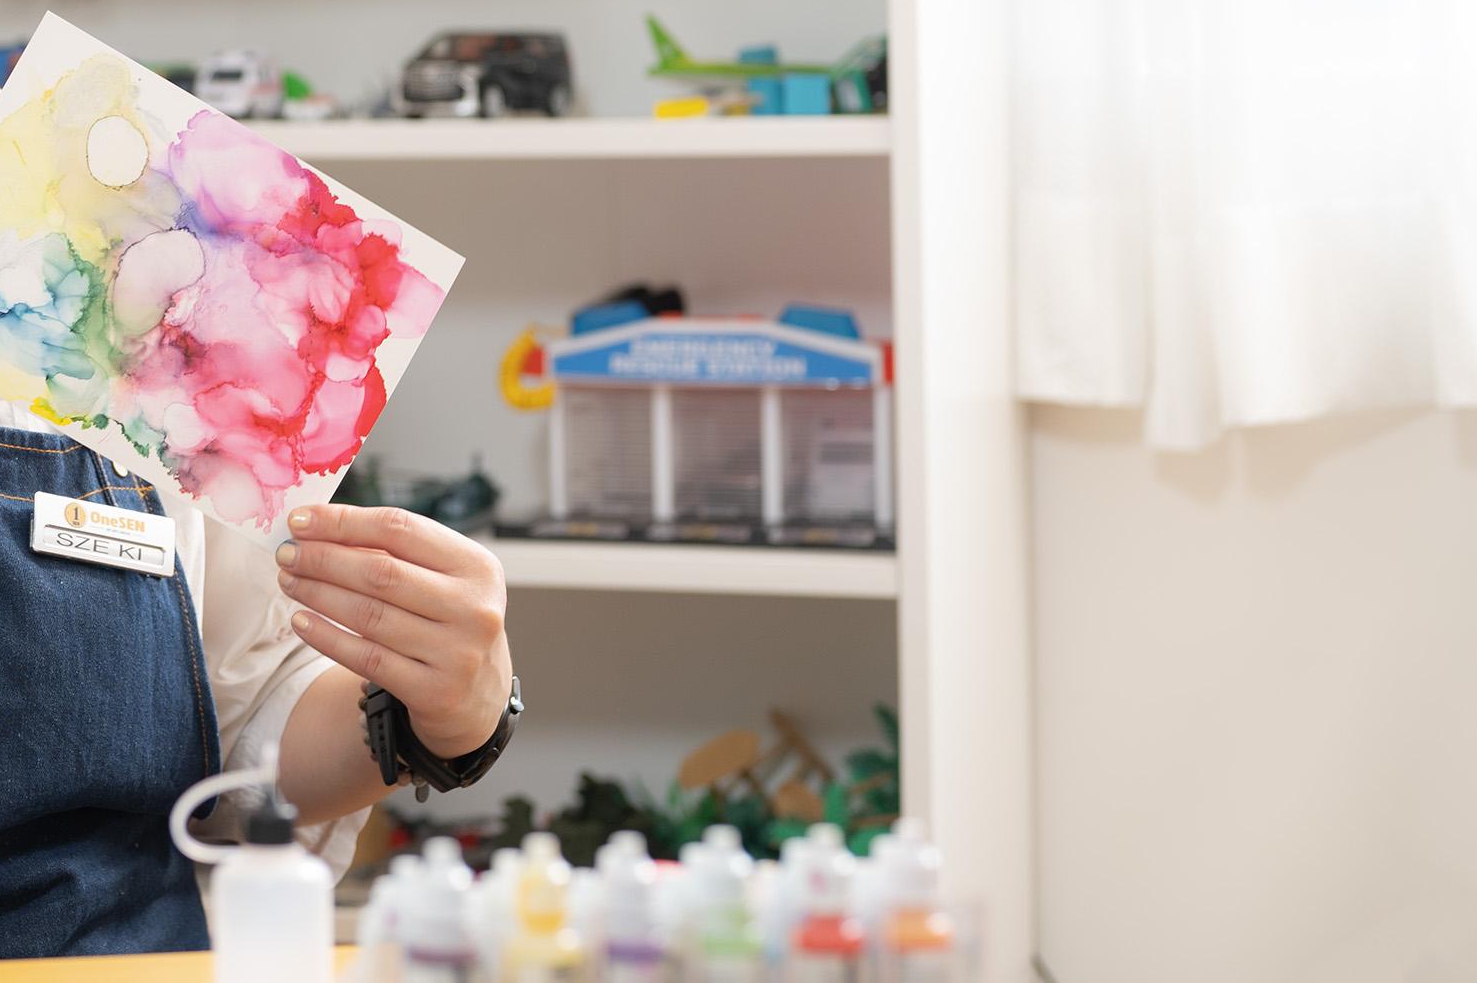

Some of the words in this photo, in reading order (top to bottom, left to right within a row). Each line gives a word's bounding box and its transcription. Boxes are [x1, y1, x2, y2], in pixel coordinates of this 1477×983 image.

[90, 511, 146, 533] OneSEN
[56, 532, 109, 555] SZE
[119, 544, 142, 561] KI
